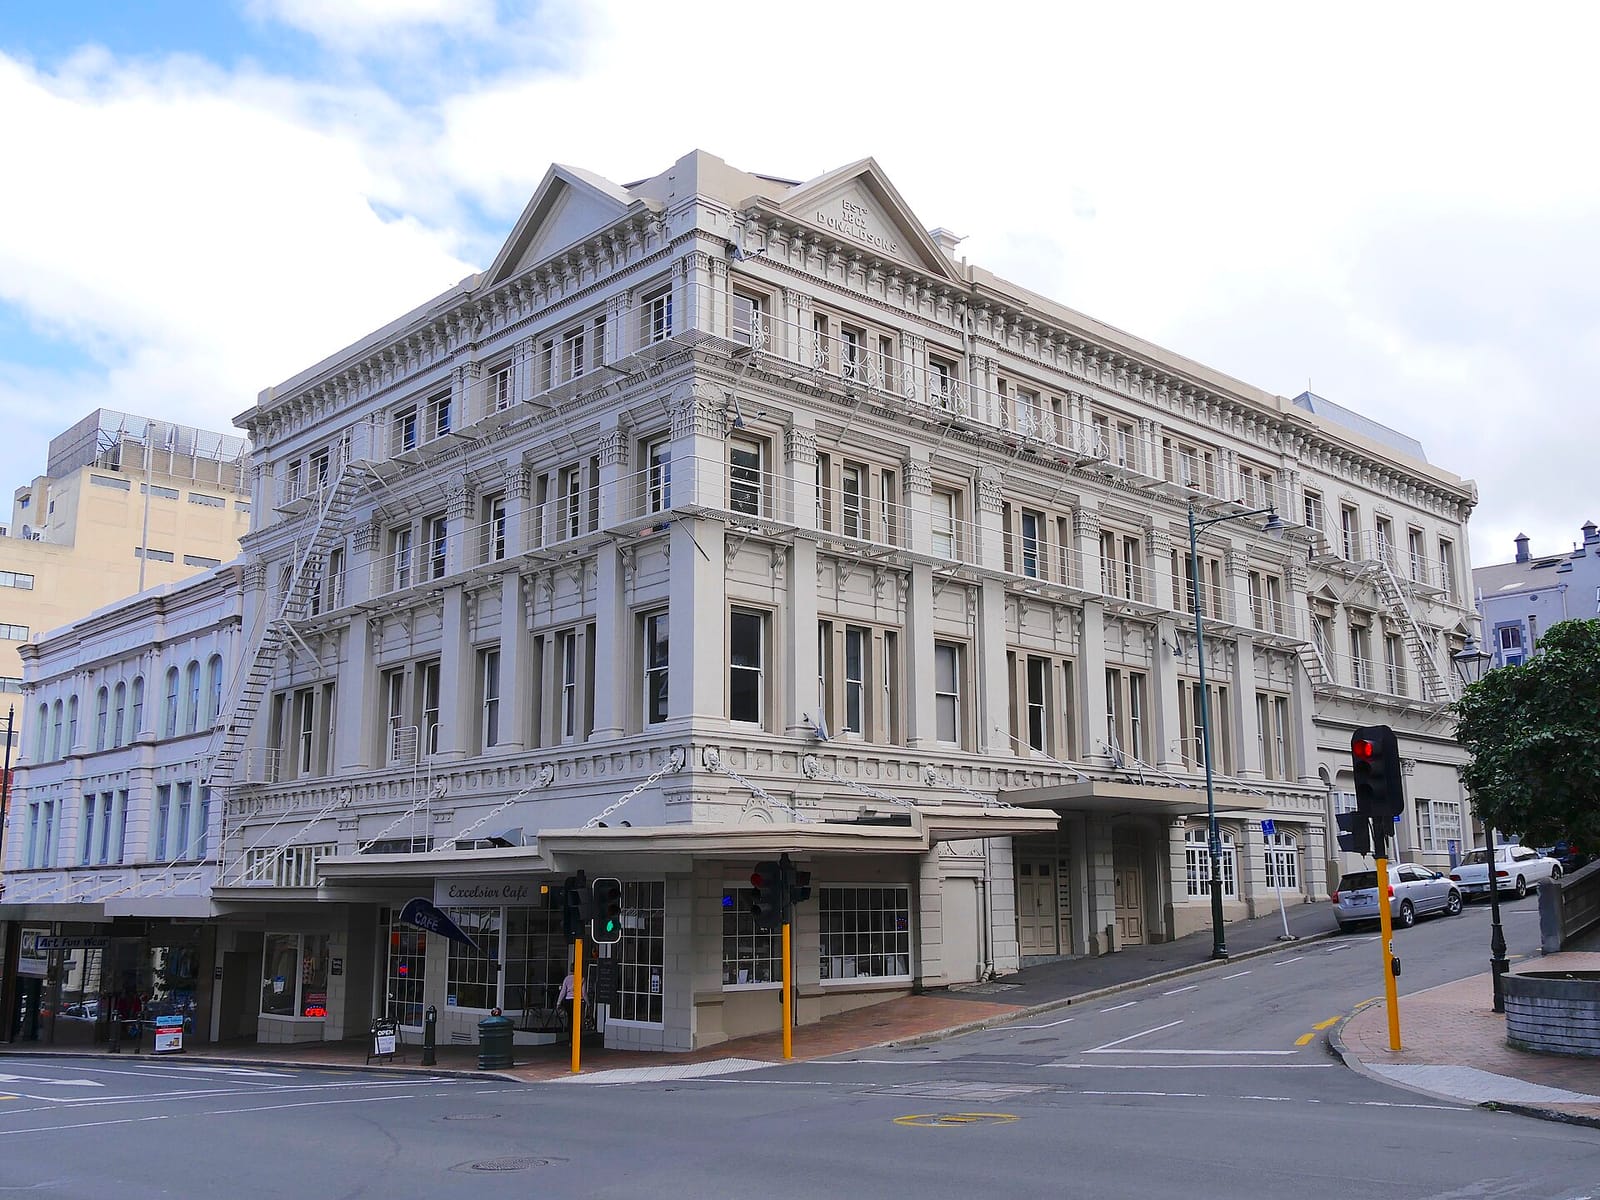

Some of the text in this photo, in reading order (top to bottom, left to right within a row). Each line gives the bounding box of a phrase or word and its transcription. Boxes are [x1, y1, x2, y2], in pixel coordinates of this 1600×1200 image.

[815, 211, 898, 254] DONALDSONS
[448, 884, 529, 902] Excelsior Café
[305, 1007, 328, 1018] OPEN
[377, 1029, 394, 1037] OPEN
